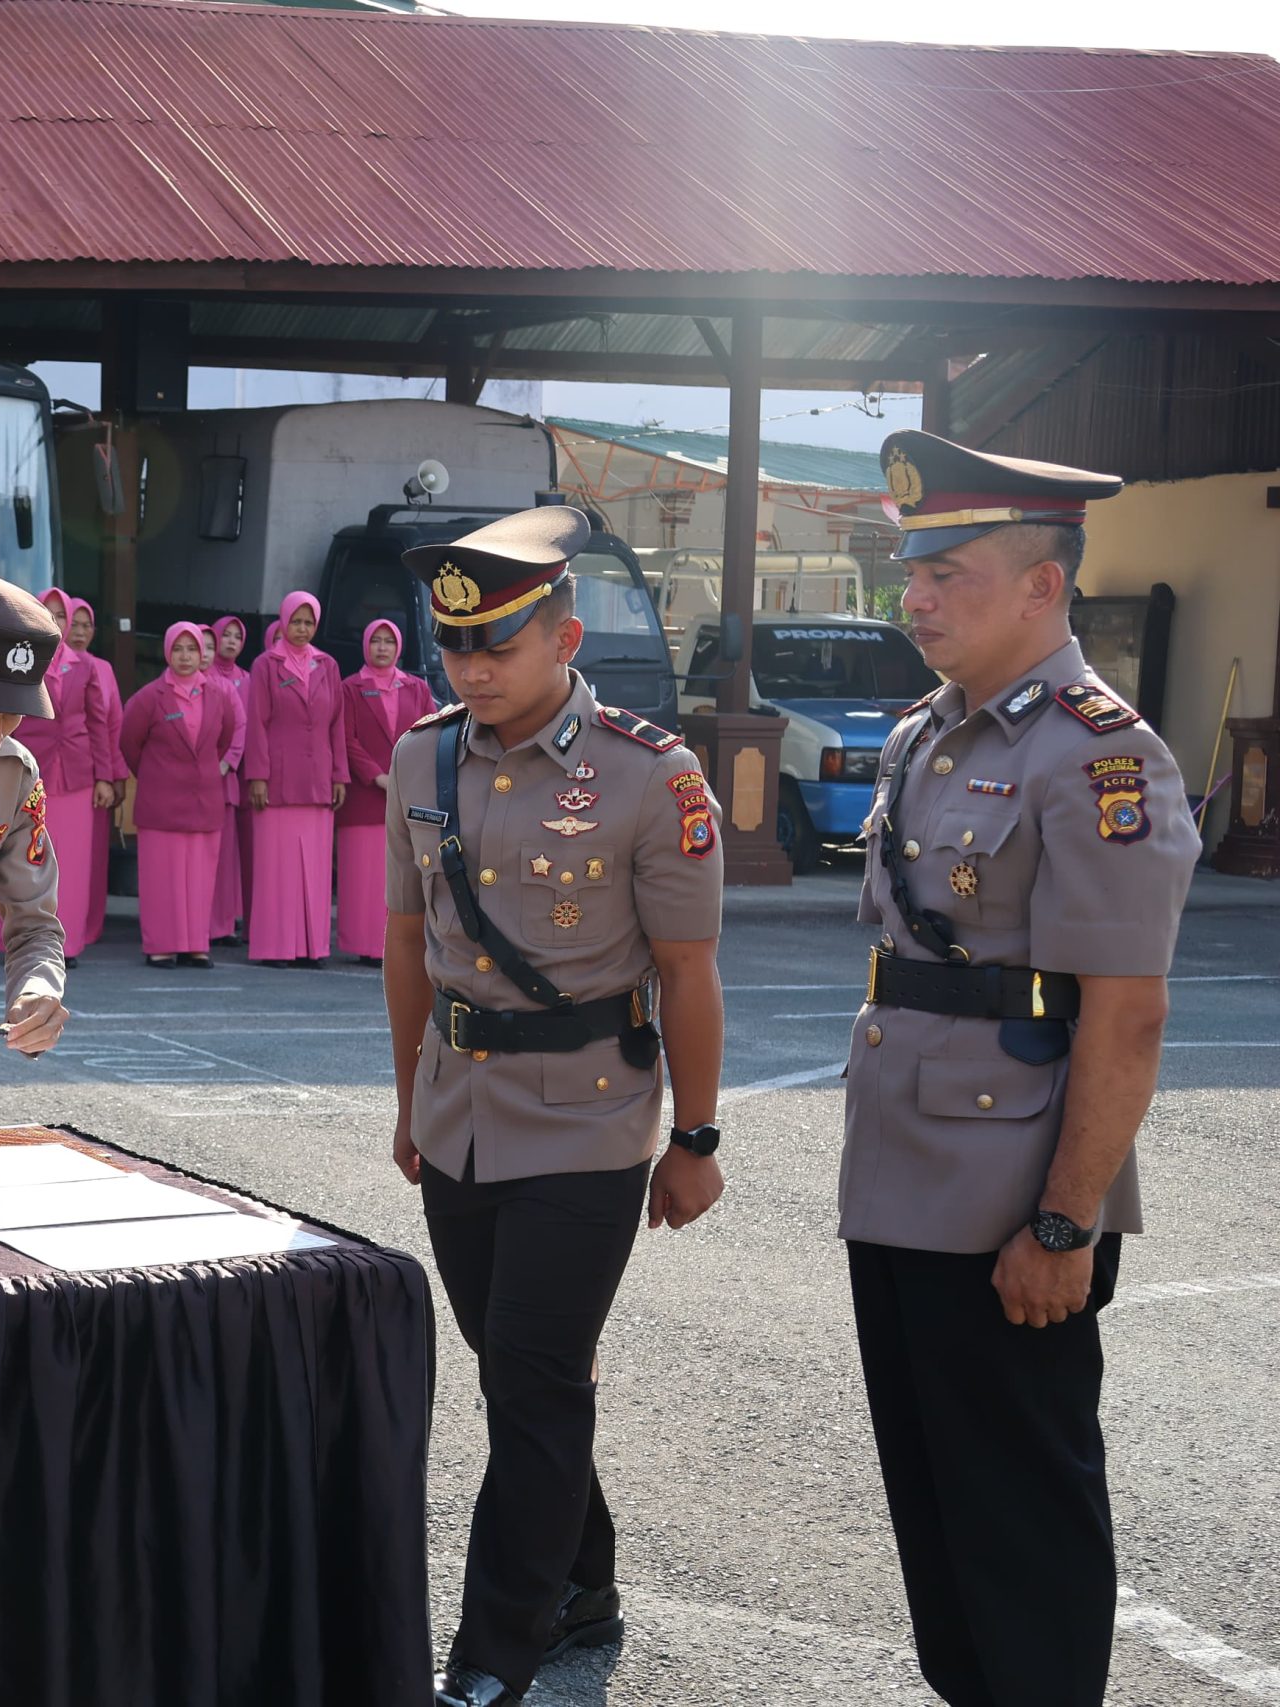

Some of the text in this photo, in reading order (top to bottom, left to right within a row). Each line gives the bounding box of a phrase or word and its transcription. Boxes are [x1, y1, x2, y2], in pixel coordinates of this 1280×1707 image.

[773, 629, 884, 642] PROPAM
[1093, 758, 1135, 769] POLRES
[1104, 777, 1136, 788] ACEH
[684, 796, 706, 808] ACEH
